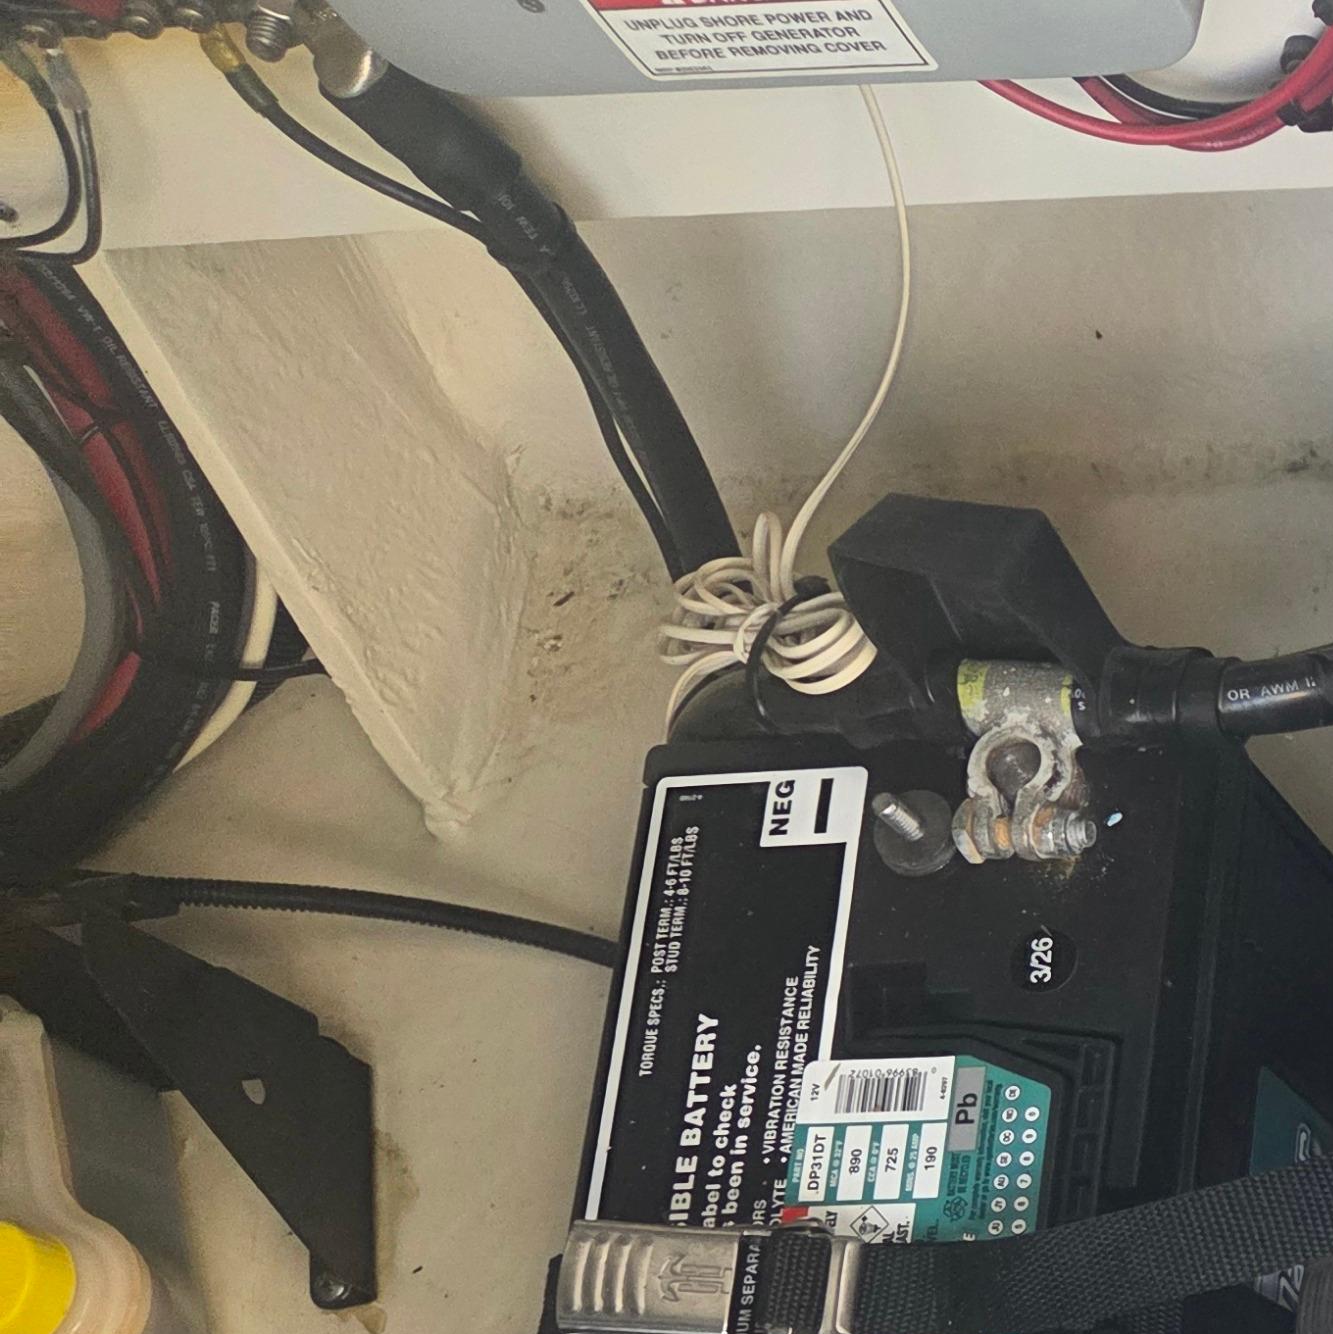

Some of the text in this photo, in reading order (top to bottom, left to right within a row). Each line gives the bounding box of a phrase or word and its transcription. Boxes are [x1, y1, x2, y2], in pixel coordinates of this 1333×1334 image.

[622, 8, 873, 31] UNPLUG SHORE POWER AND
[659, 25, 861, 45] TURN OFF GENERATOR
[654, 39, 887, 61] BEFORE REMOVING COVER
[1226, 679, 1300, 702] OR AWM
[768, 778, 796, 836] NEG
[637, 835, 684, 1077] TORQUE POST FT/LBS
[663, 940, 681, 973] STUD
[1028, 936, 1054, 984] 3/26
[761, 975, 799, 1154] VIBRATION RESISTANCE
[778, 944, 821, 1154] AMERICAN MADE RELIABILITY
[679, 1012, 719, 1146] BATTERY
[809, 1082, 821, 1101] 12V
[711, 1082, 738, 1149] check
[953, 1091, 978, 1125] Pb
[720, 1159, 745, 1214] been
[736, 1043, 762, 1129] service.
[706, 1153, 726, 1177] to
[806, 1132, 827, 1191] DP31DT
[847, 1147, 863, 1175] 890
[883, 1146, 899, 1173] 725
[923, 1145, 938, 1171] 190
